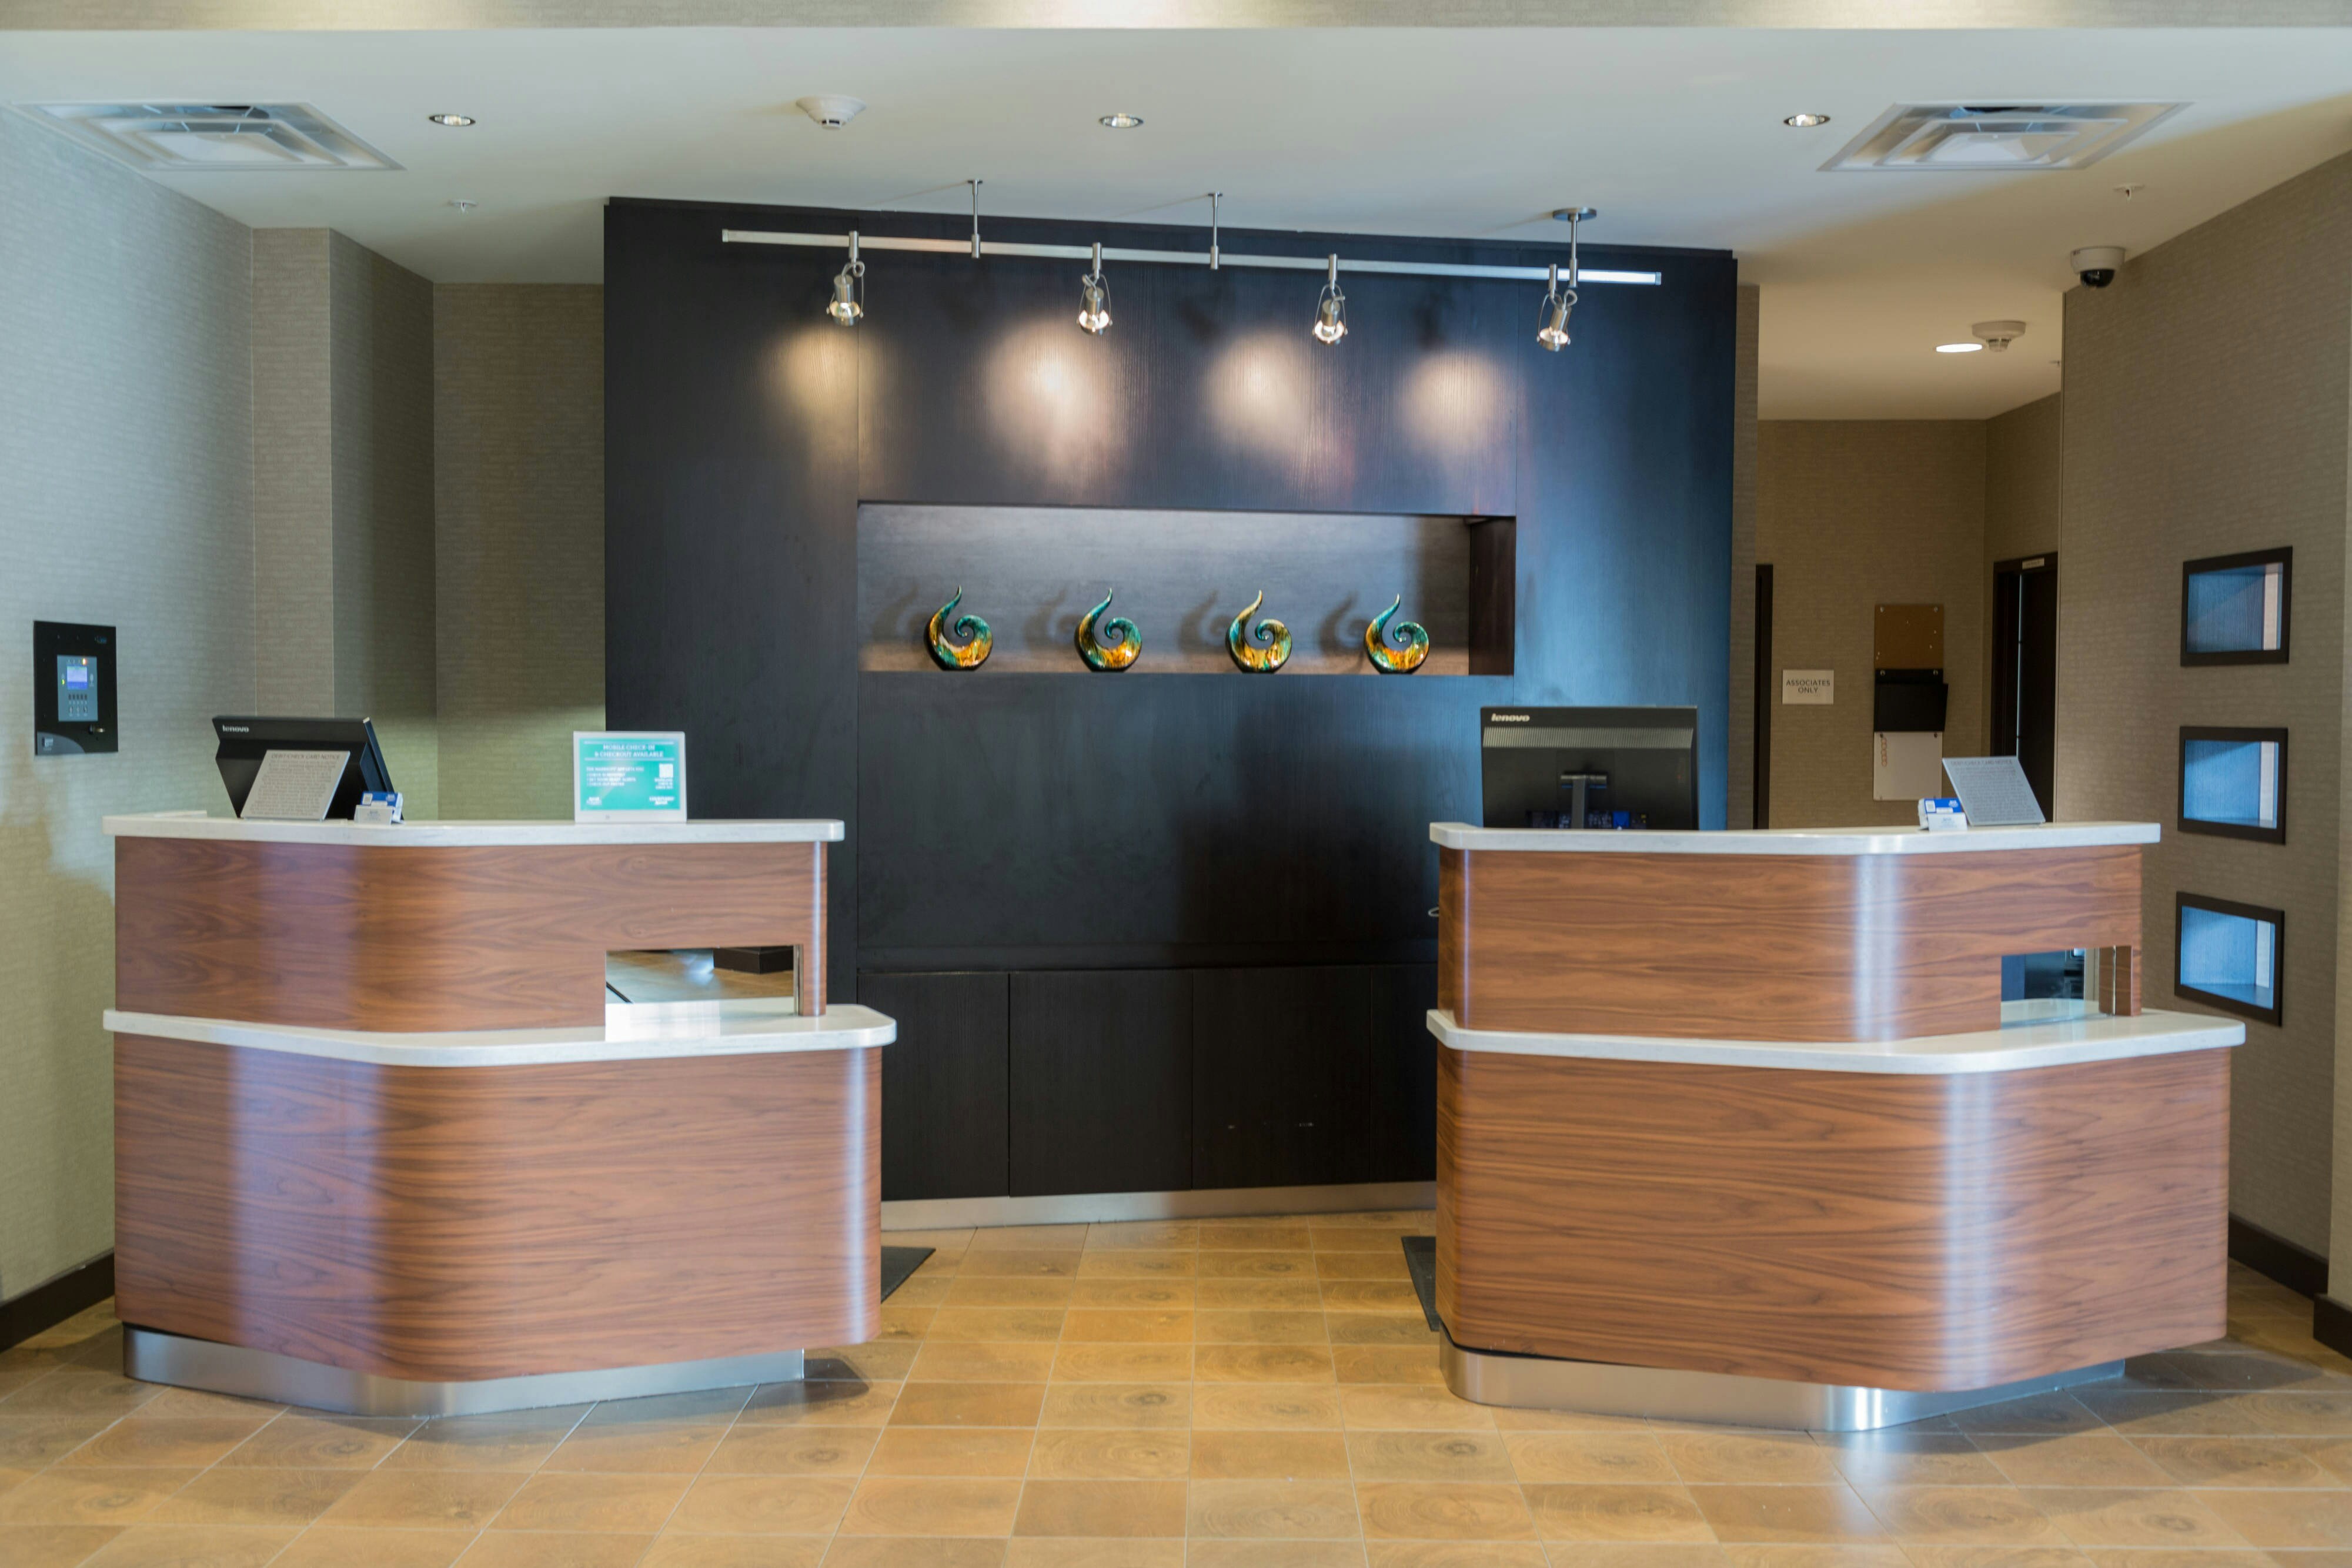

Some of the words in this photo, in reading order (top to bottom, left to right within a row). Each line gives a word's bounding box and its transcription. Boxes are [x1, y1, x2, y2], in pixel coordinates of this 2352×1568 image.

[1786, 678, 1830, 687] ASSOCIATES
[1491, 713, 1530, 722] lenovo
[222, 724, 249, 733] lenovo
